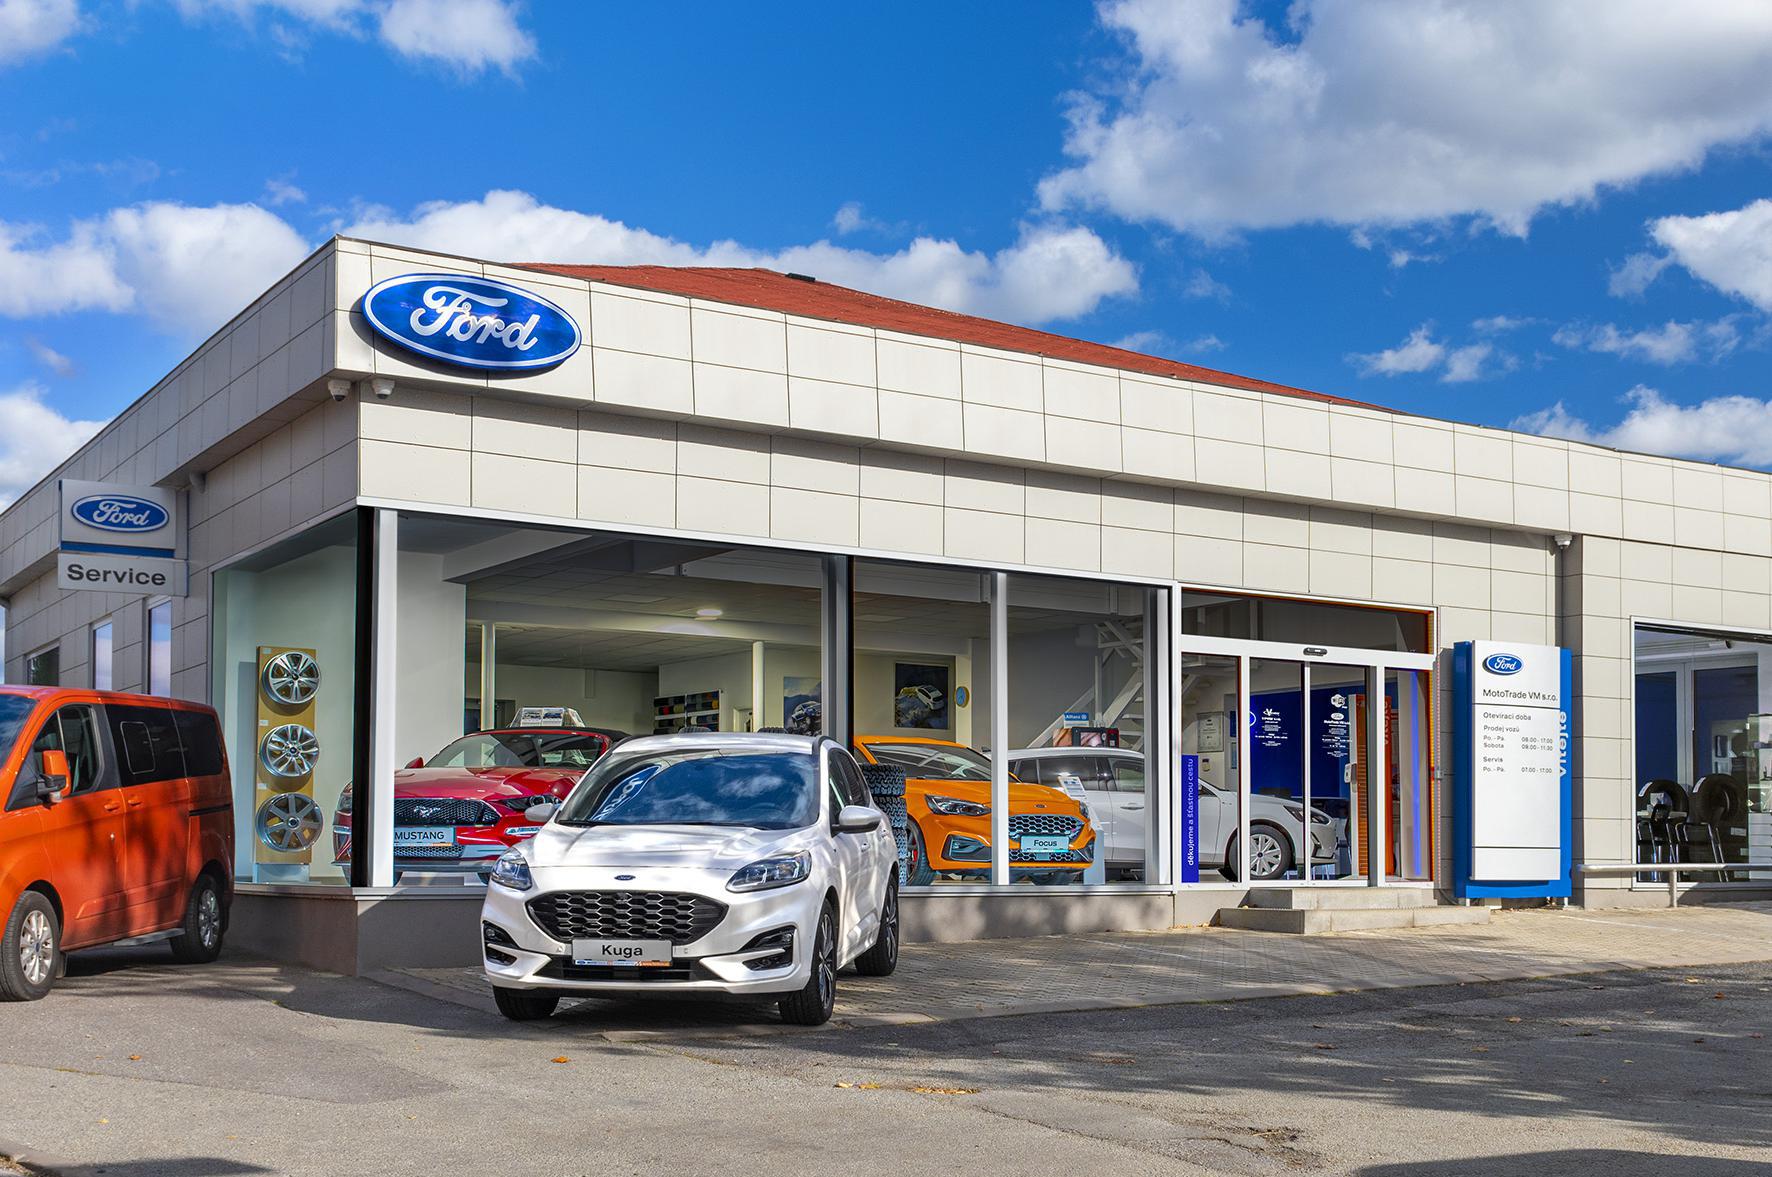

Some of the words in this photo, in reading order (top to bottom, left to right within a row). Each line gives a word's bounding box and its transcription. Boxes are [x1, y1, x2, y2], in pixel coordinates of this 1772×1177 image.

[410, 286, 540, 351] Ford
[93, 500, 151, 525] Ford
[67, 564, 166, 586] Service
[1494, 656, 1517, 670] Ford
[1482, 689, 1527, 699] MotoTrade
[1528, 691, 1541, 700] VM
[1515, 712, 1532, 721] doba
[1483, 725, 1505, 733] Prodej
[394, 831, 445, 840] MUSTANG
[1033, 839, 1058, 847] Focus
[601, 944, 643, 959] Kuga
